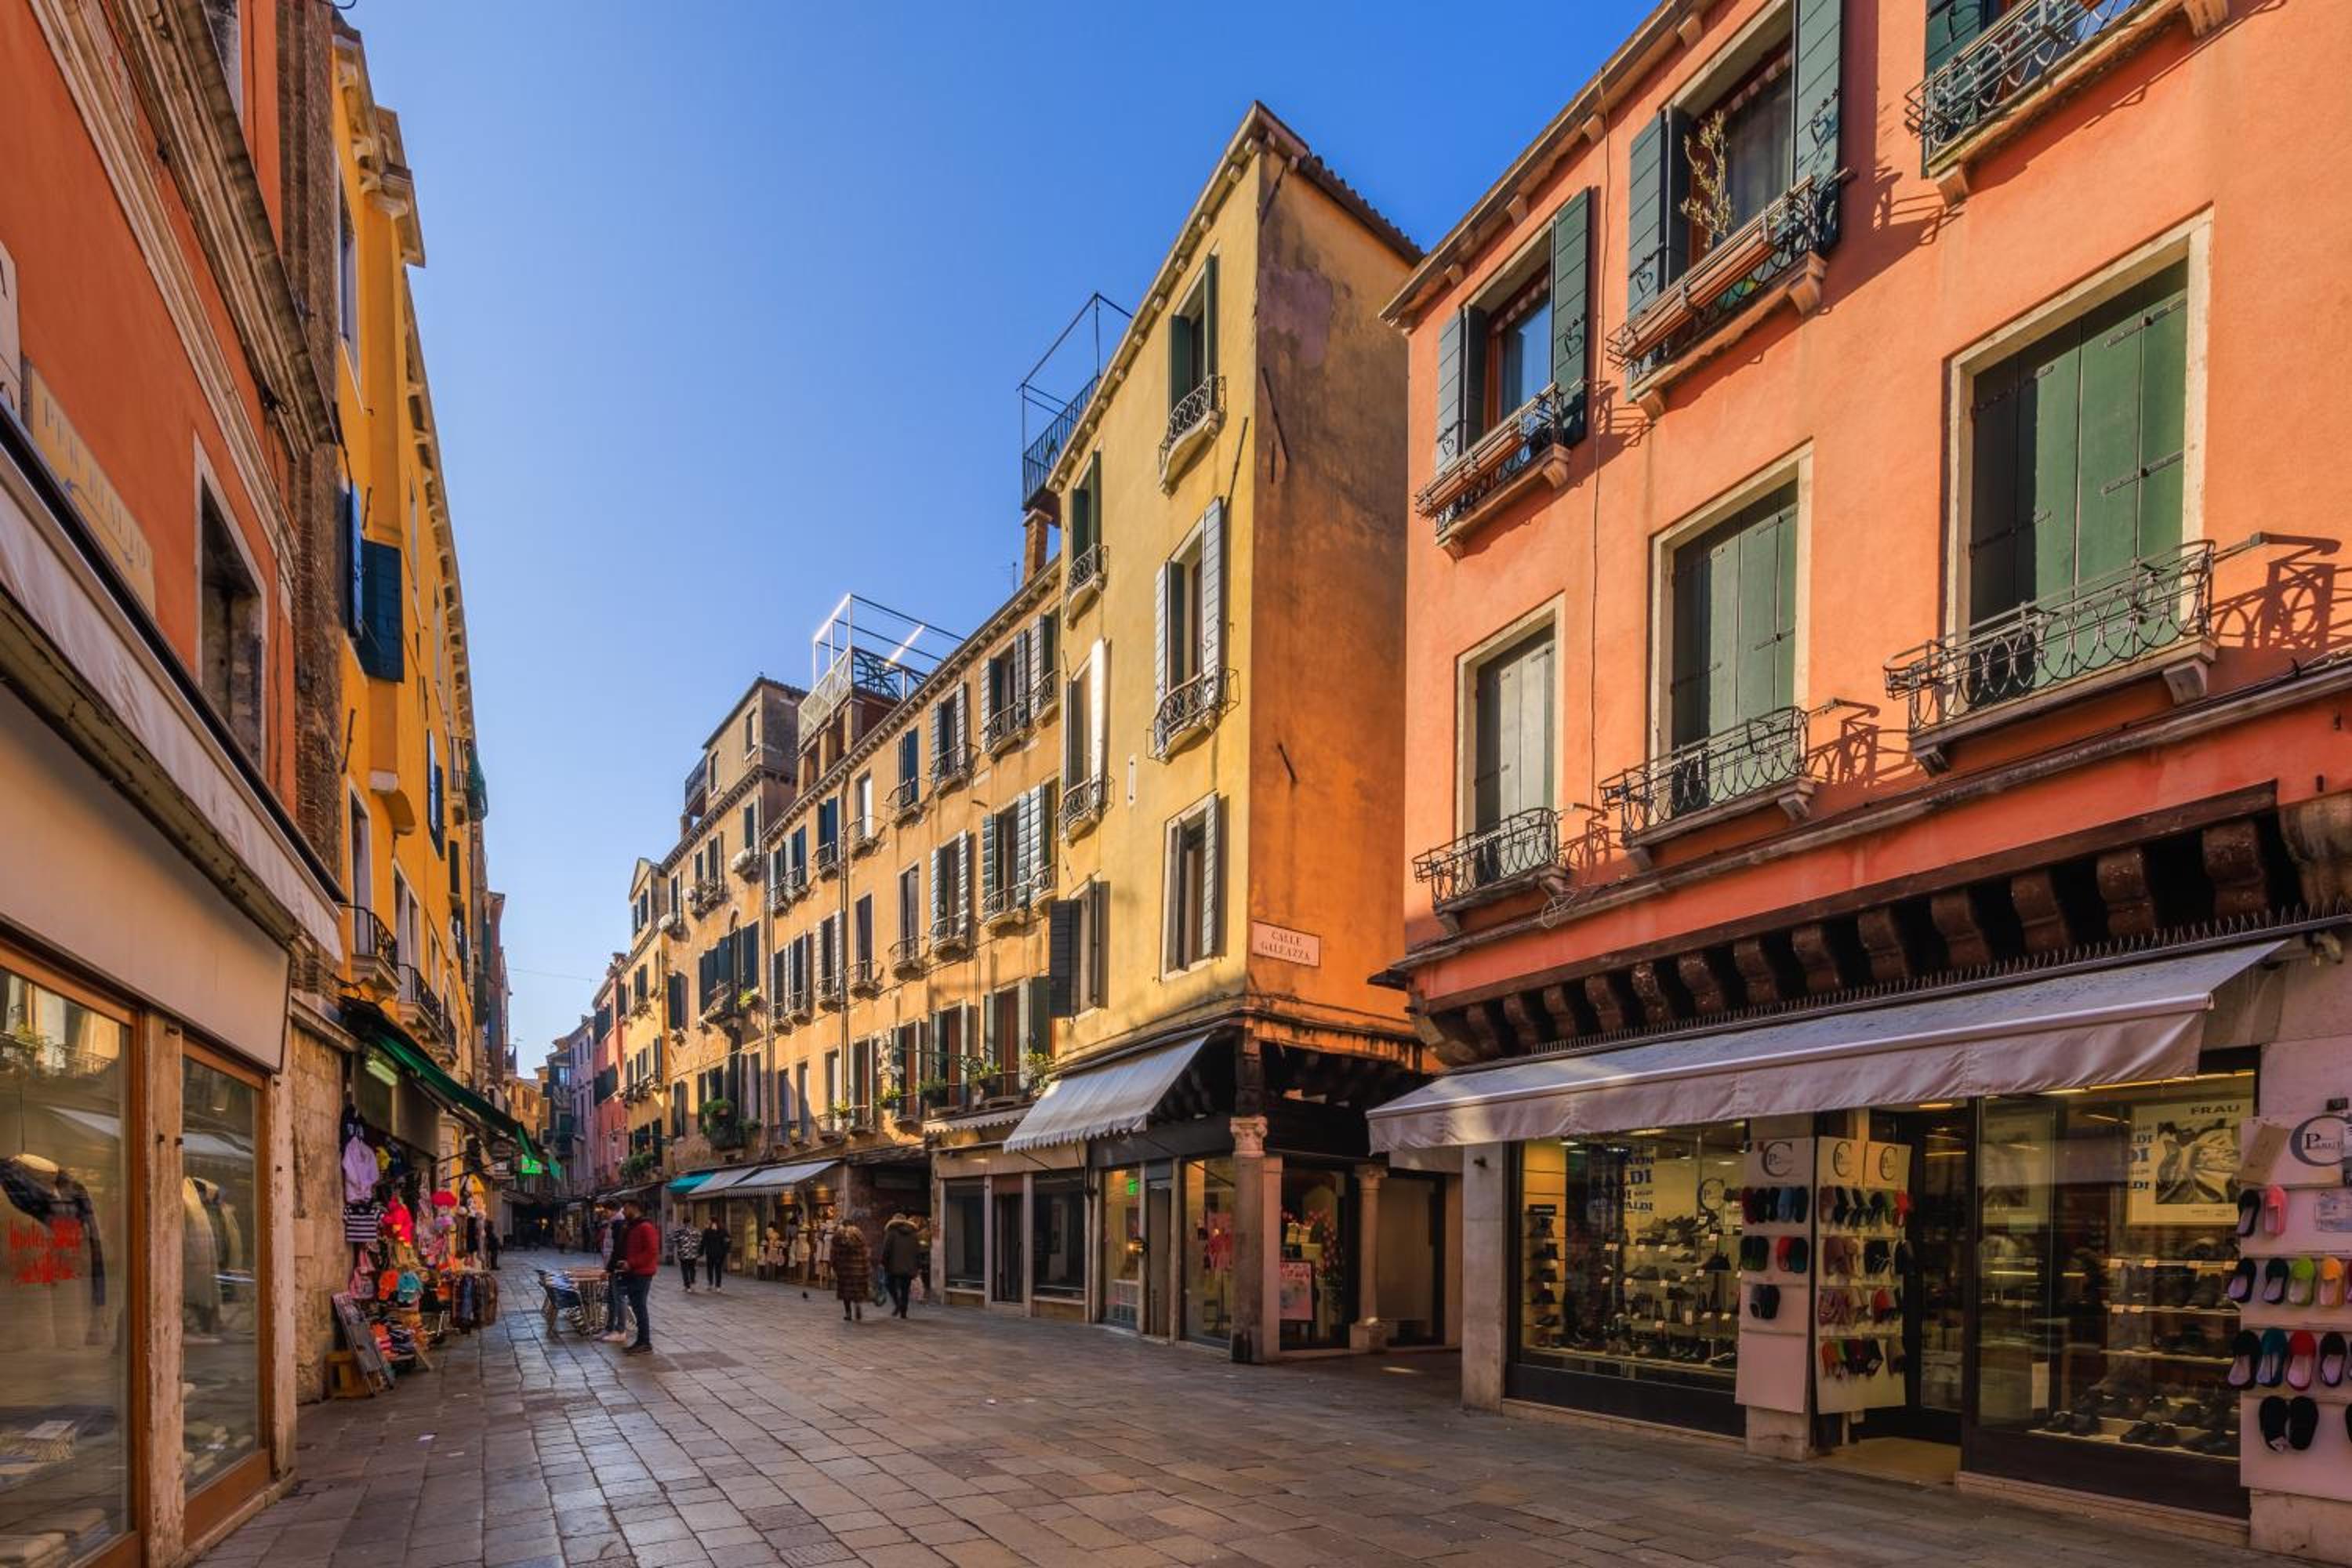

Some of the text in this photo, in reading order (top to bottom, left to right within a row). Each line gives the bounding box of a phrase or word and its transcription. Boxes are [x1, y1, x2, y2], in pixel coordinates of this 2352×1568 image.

[1271, 931, 1303, 947] CALLE
[1260, 940, 1311, 963] GALEAZZA
[2190, 1105, 2240, 1115] FRAU
